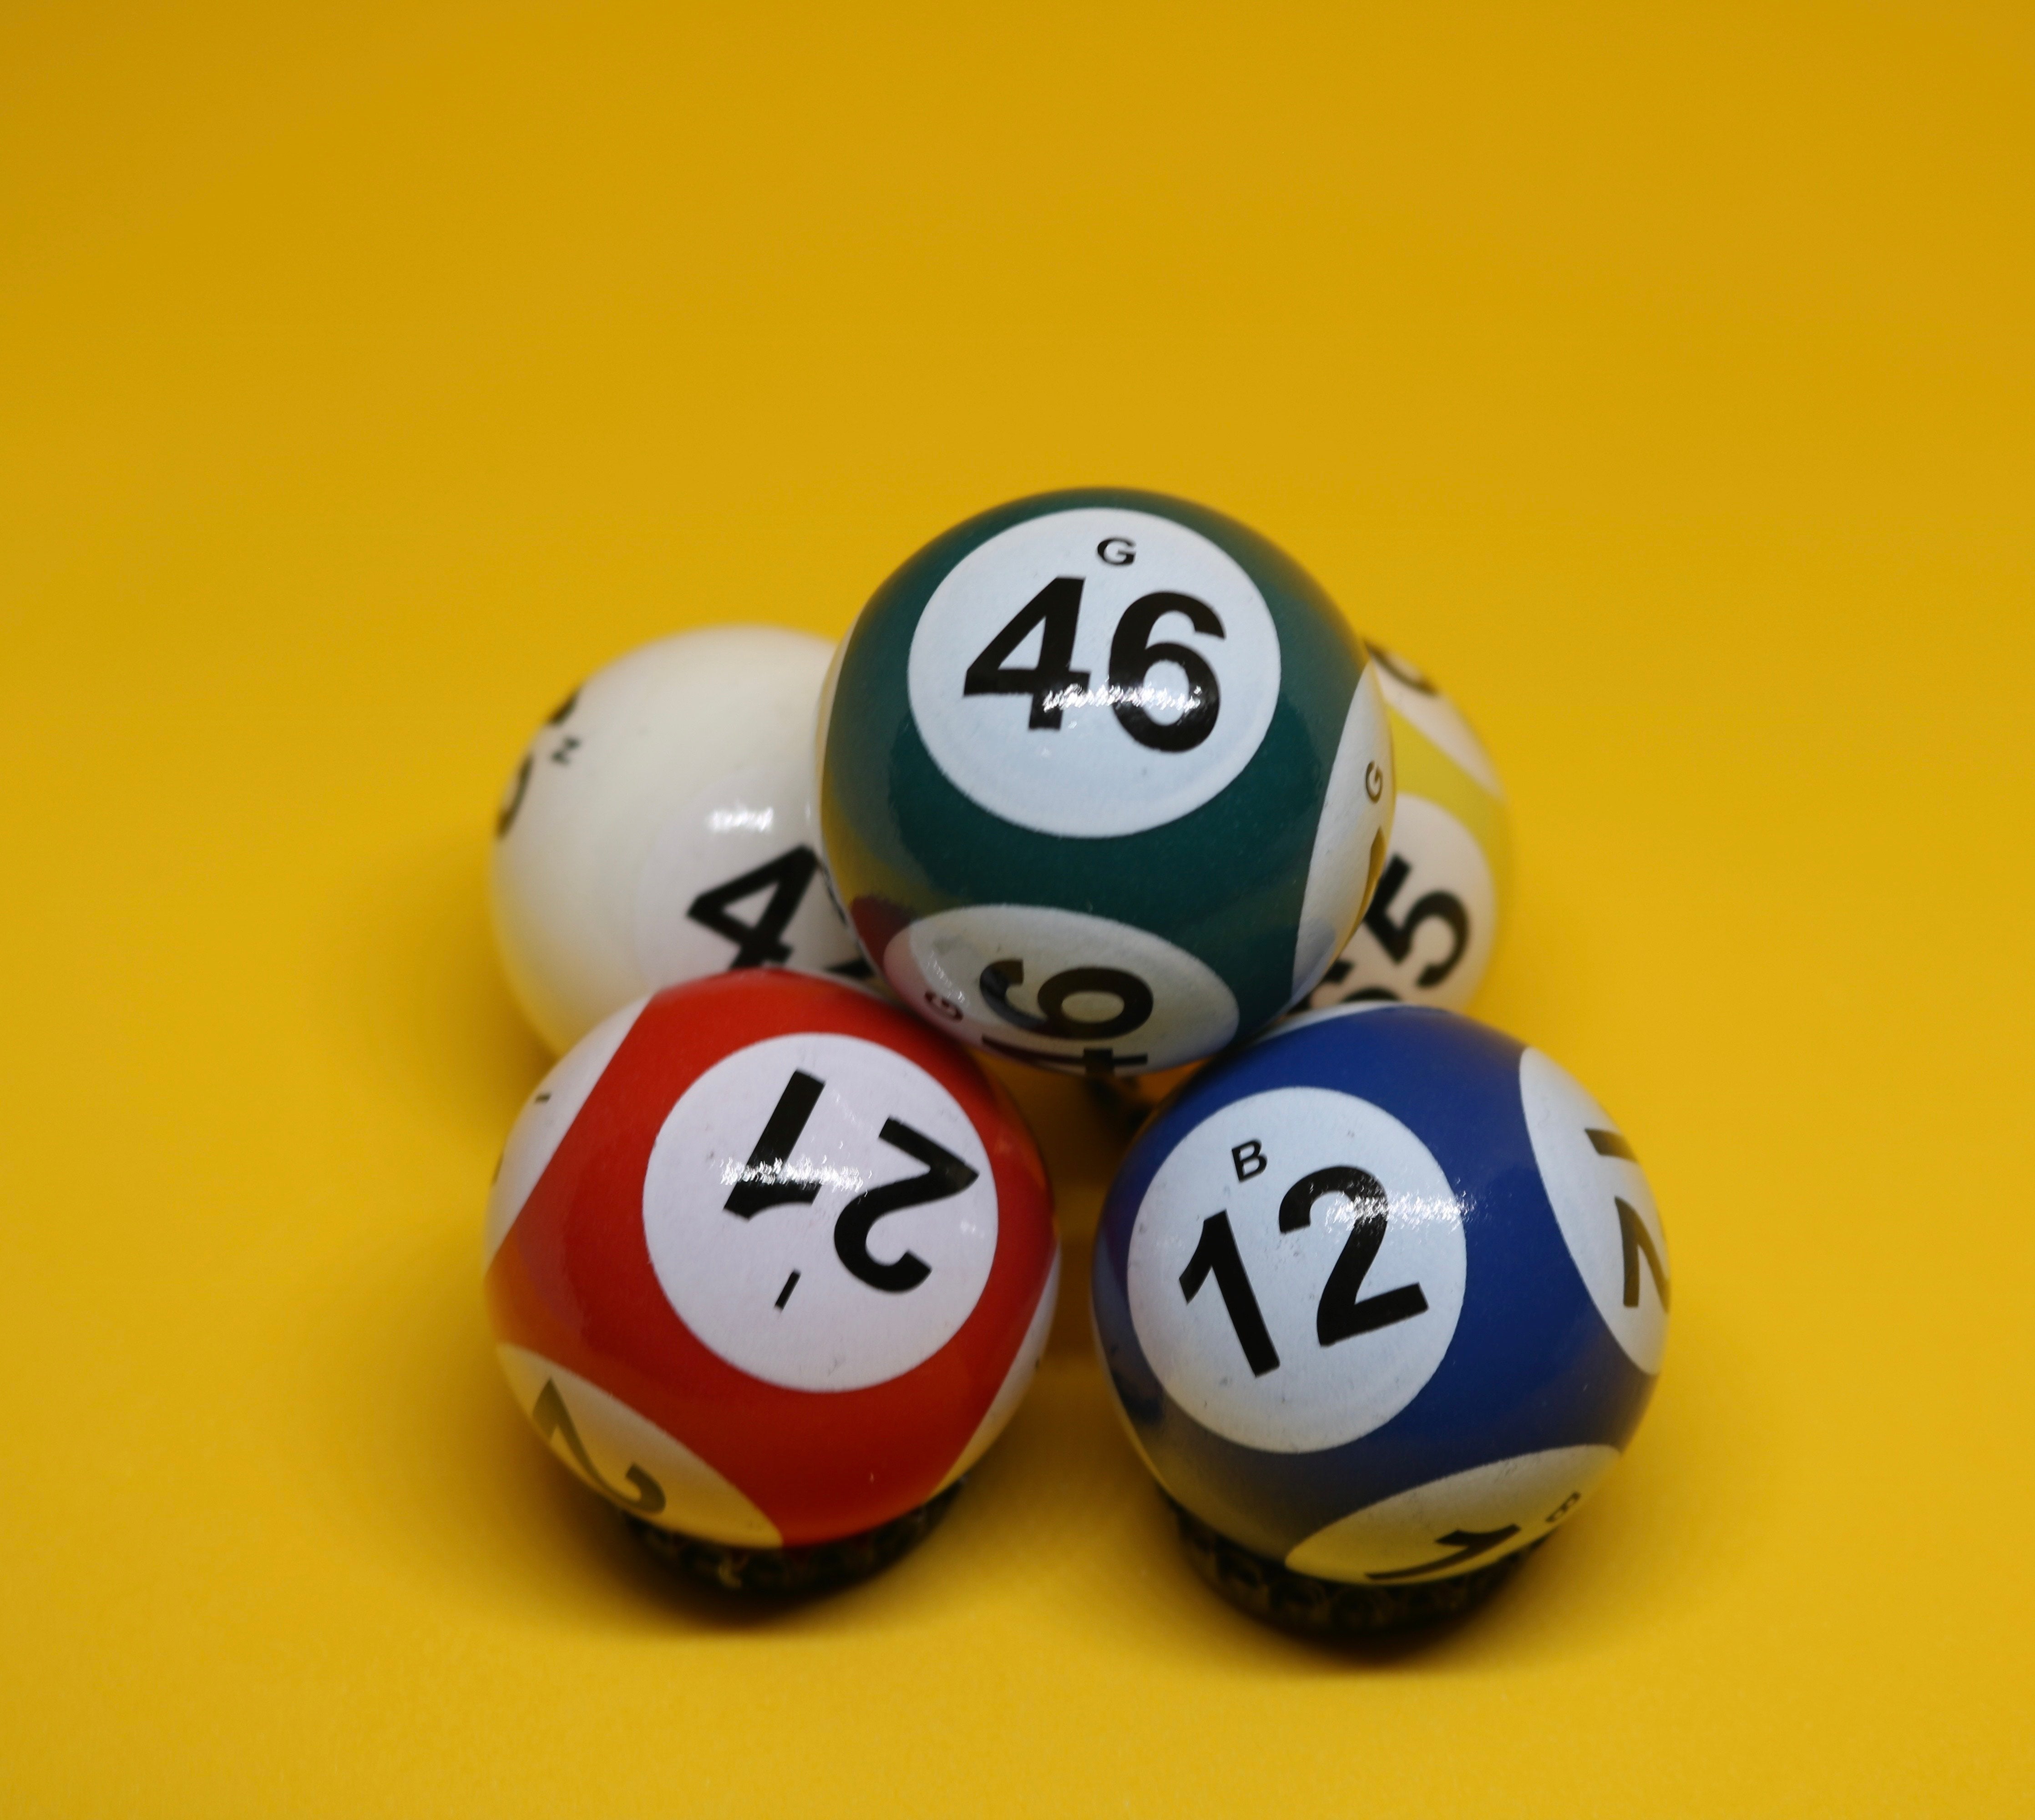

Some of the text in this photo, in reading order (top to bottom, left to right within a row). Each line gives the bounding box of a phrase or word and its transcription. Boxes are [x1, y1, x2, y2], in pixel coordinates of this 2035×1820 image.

[1097, 537, 1137, 566] G
[963, 576, 1226, 753] 46
[1366, 760, 1384, 804] G
[686, 843, 874, 981] 4
[1301, 853, 1468, 1011] 5
[723, 1068, 980, 1295] 21
[1231, 1139, 1268, 1183] B
[1179, 1165, 1429, 1378] 12
